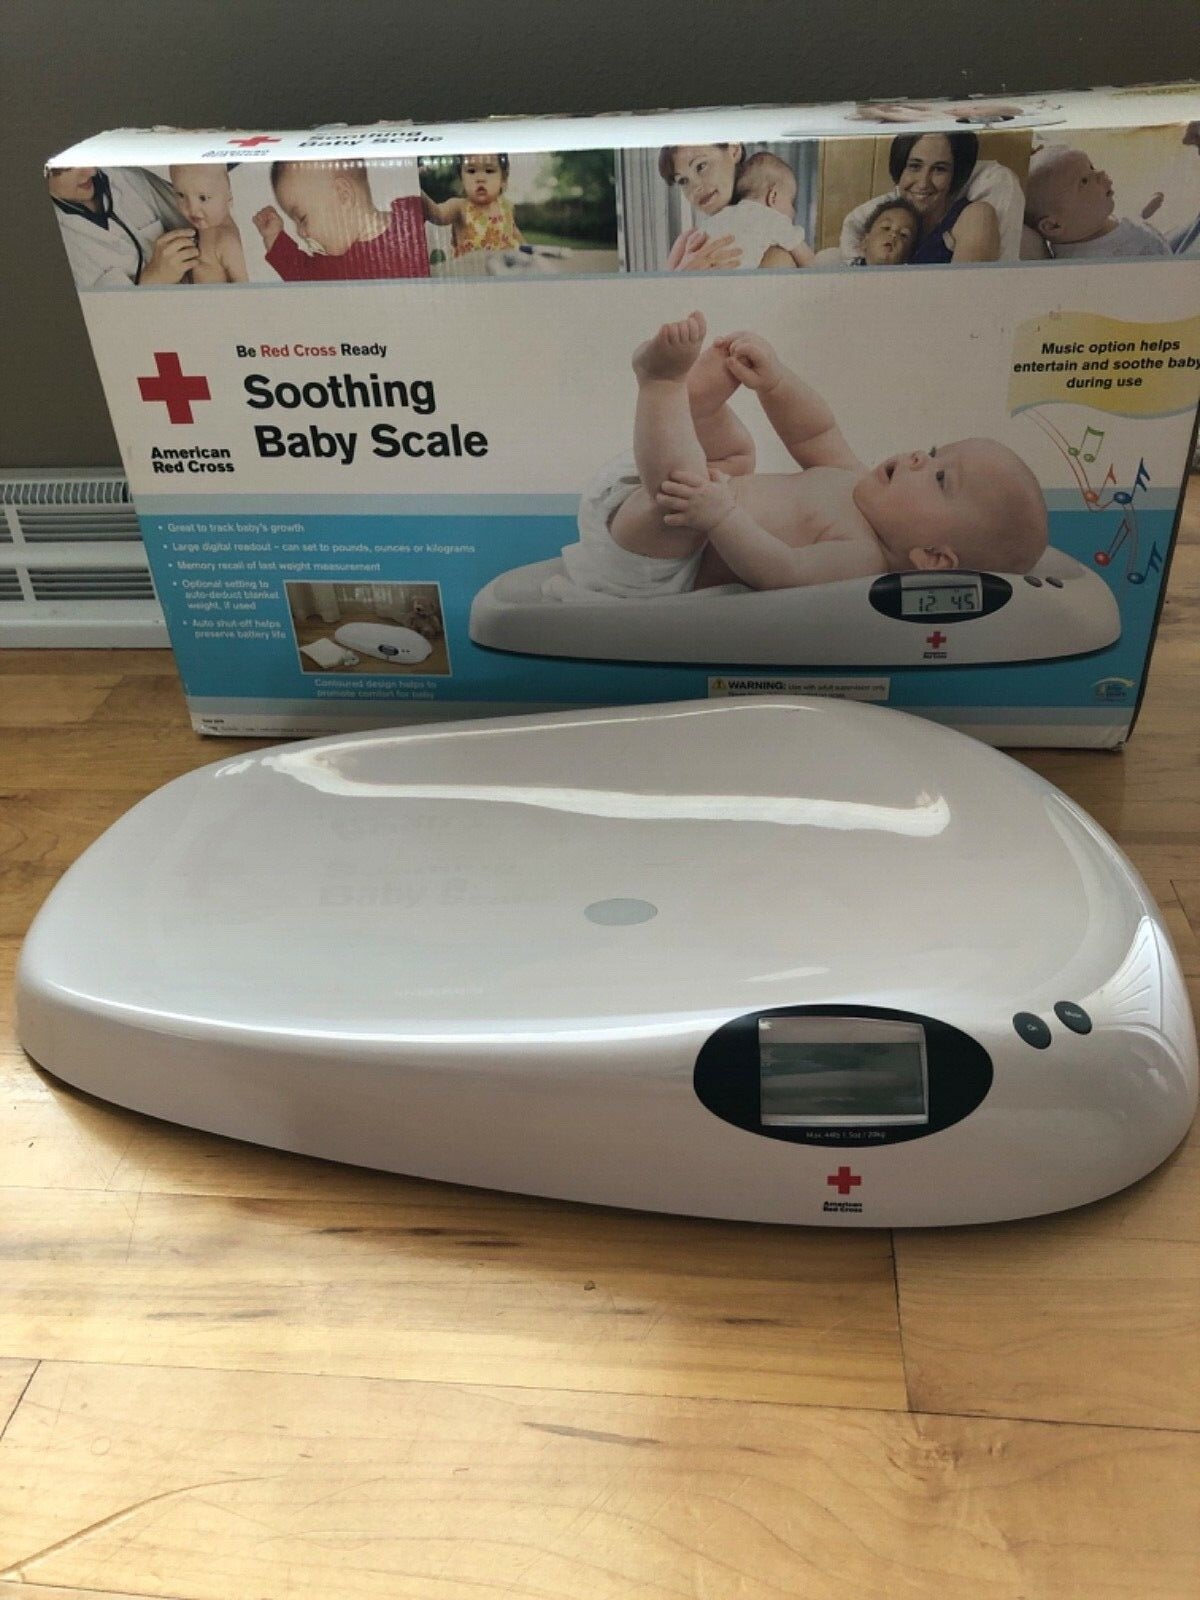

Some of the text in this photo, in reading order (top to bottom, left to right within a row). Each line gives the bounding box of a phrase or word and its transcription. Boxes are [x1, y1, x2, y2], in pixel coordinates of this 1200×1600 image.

[236, 342, 388, 359] Be Red Cross Ready
[1041, 339, 1180, 355] Music option helps
[1013, 356, 1200, 373] entertain and soothe baby
[1066, 377, 1143, 389] during use
[243, 372, 436, 414] Soothing
[254, 423, 489, 465] Baby Scale
[151, 446, 231, 460] American
[153, 459, 235, 474] Red Cross
[167, 523, 305, 534] Great to track baby's growth
[172, 543, 199, 552] Large
[202, 543, 231, 552] digital
[234, 543, 271, 552] readout
[282, 544, 299, 552] can
[302, 543, 317, 552] set
[320, 543, 330, 552] to
[332, 543, 372, 553] pounds,
[426, 543, 476, 554] kilograms
[177, 561, 380, 572] Memory recall of last weight measurement
[182, 580, 269, 590] Optional setting to
[233, 602, 256, 610] used
[255, 619, 281, 629] helps
[272, 630, 286, 639] life
[728, 680, 786, 691] WARNING:
